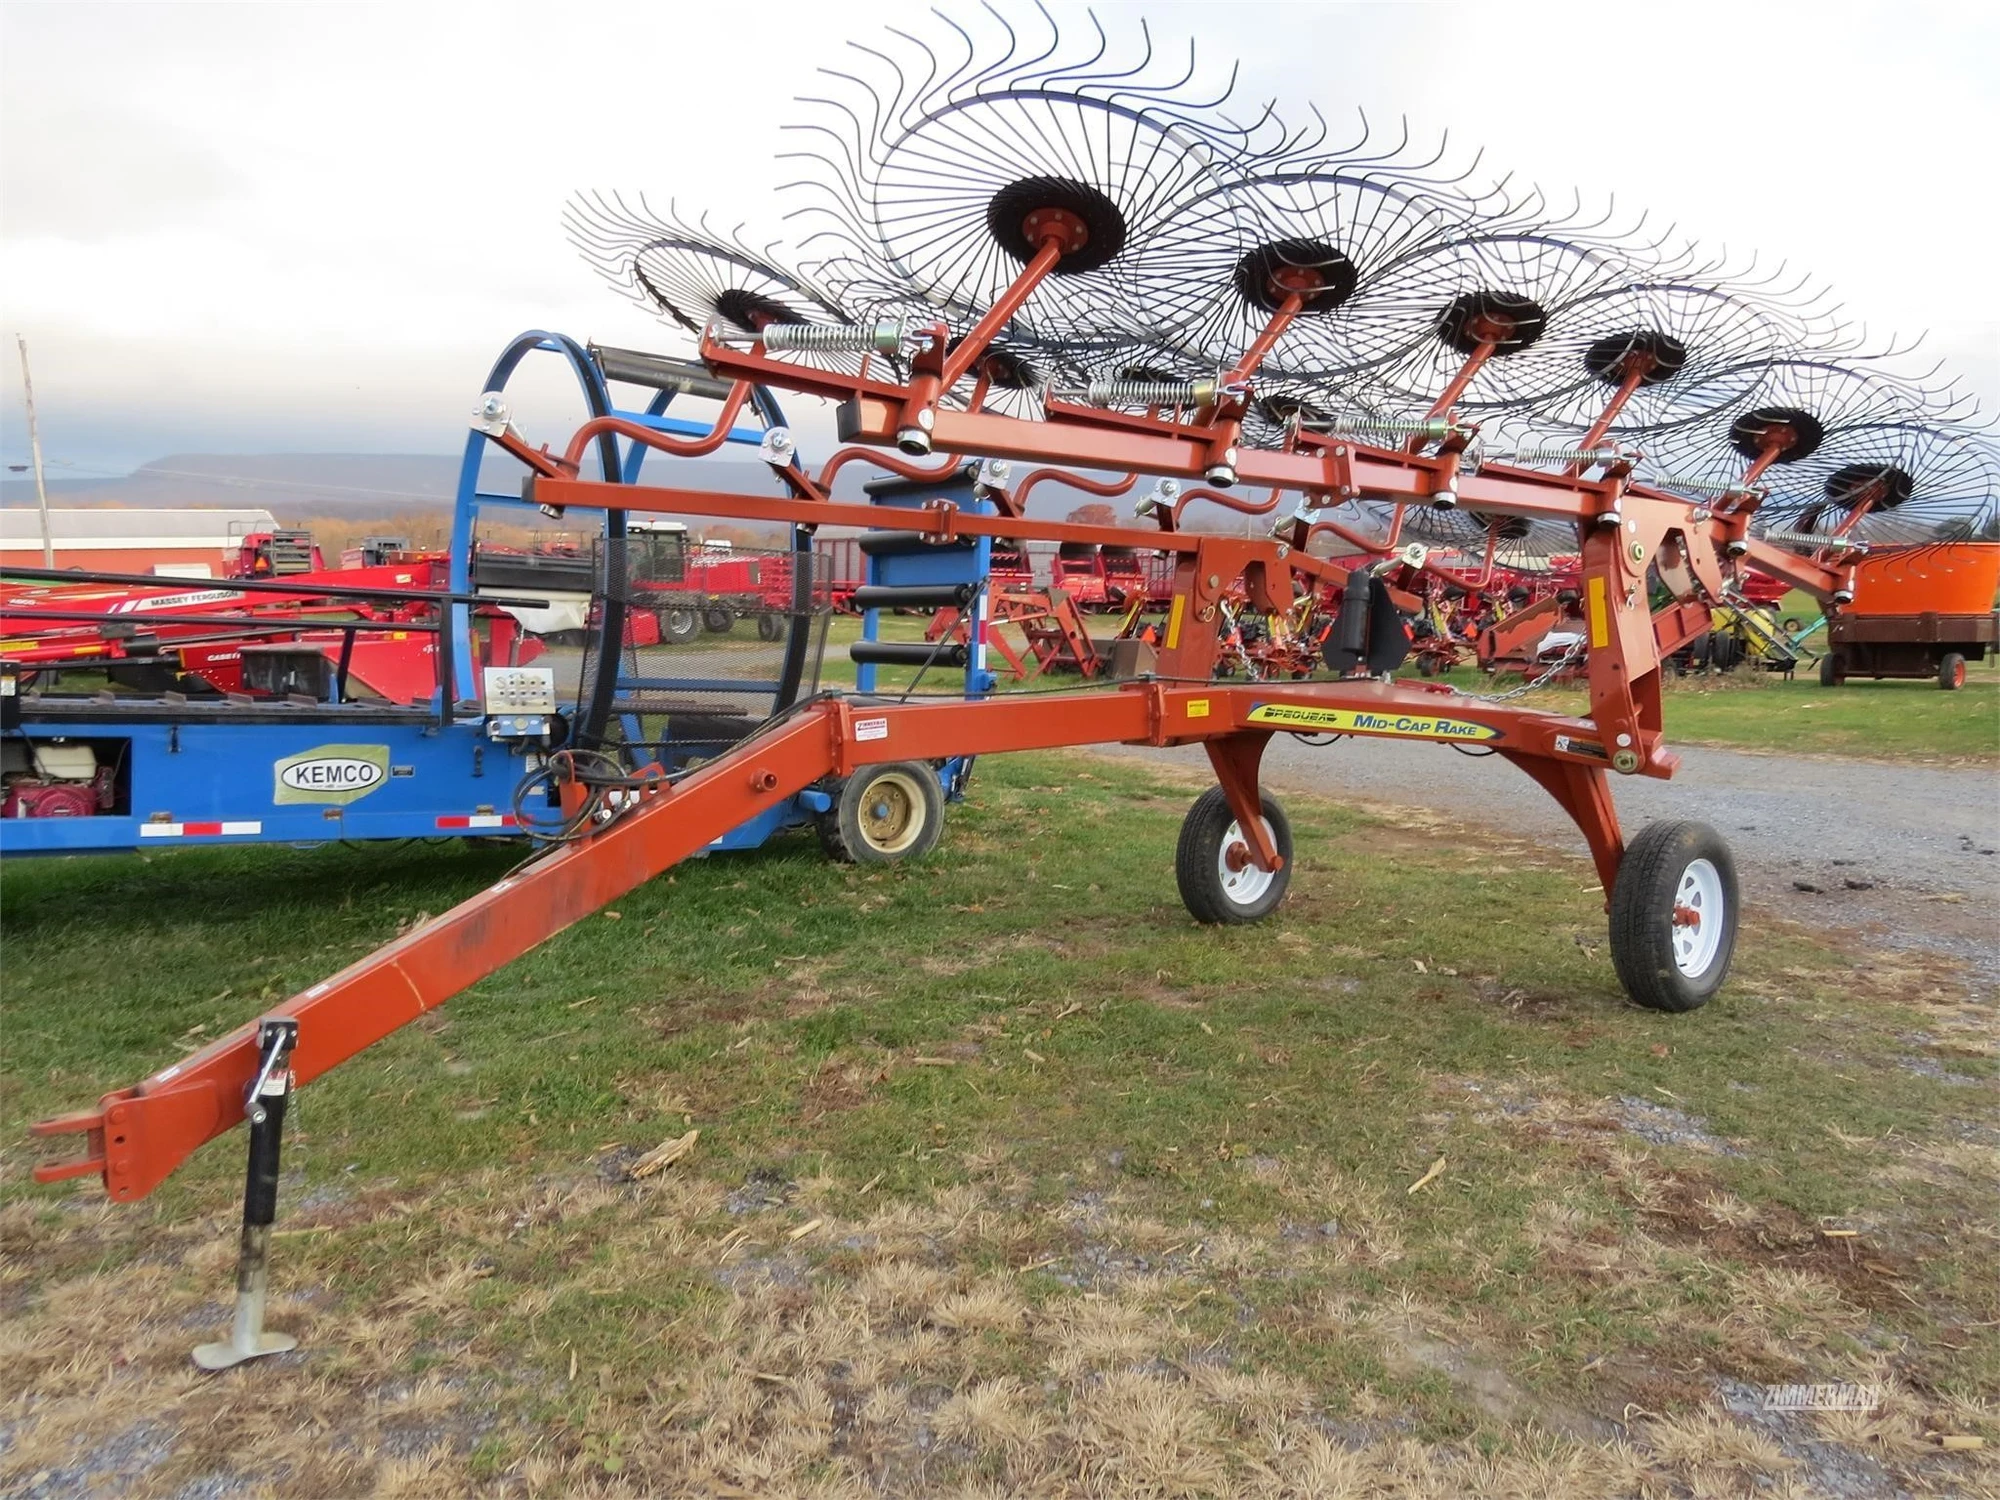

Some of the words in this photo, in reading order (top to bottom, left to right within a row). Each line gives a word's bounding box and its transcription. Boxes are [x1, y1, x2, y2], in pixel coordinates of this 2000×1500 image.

[151, 597, 189, 606] MASSEY
[191, 591, 239, 602] FERGUSON
[1353, 714, 1431, 731] MID-CAP
[1434, 721, 1478, 736] RAKE
[296, 764, 373, 784] KEMCO
